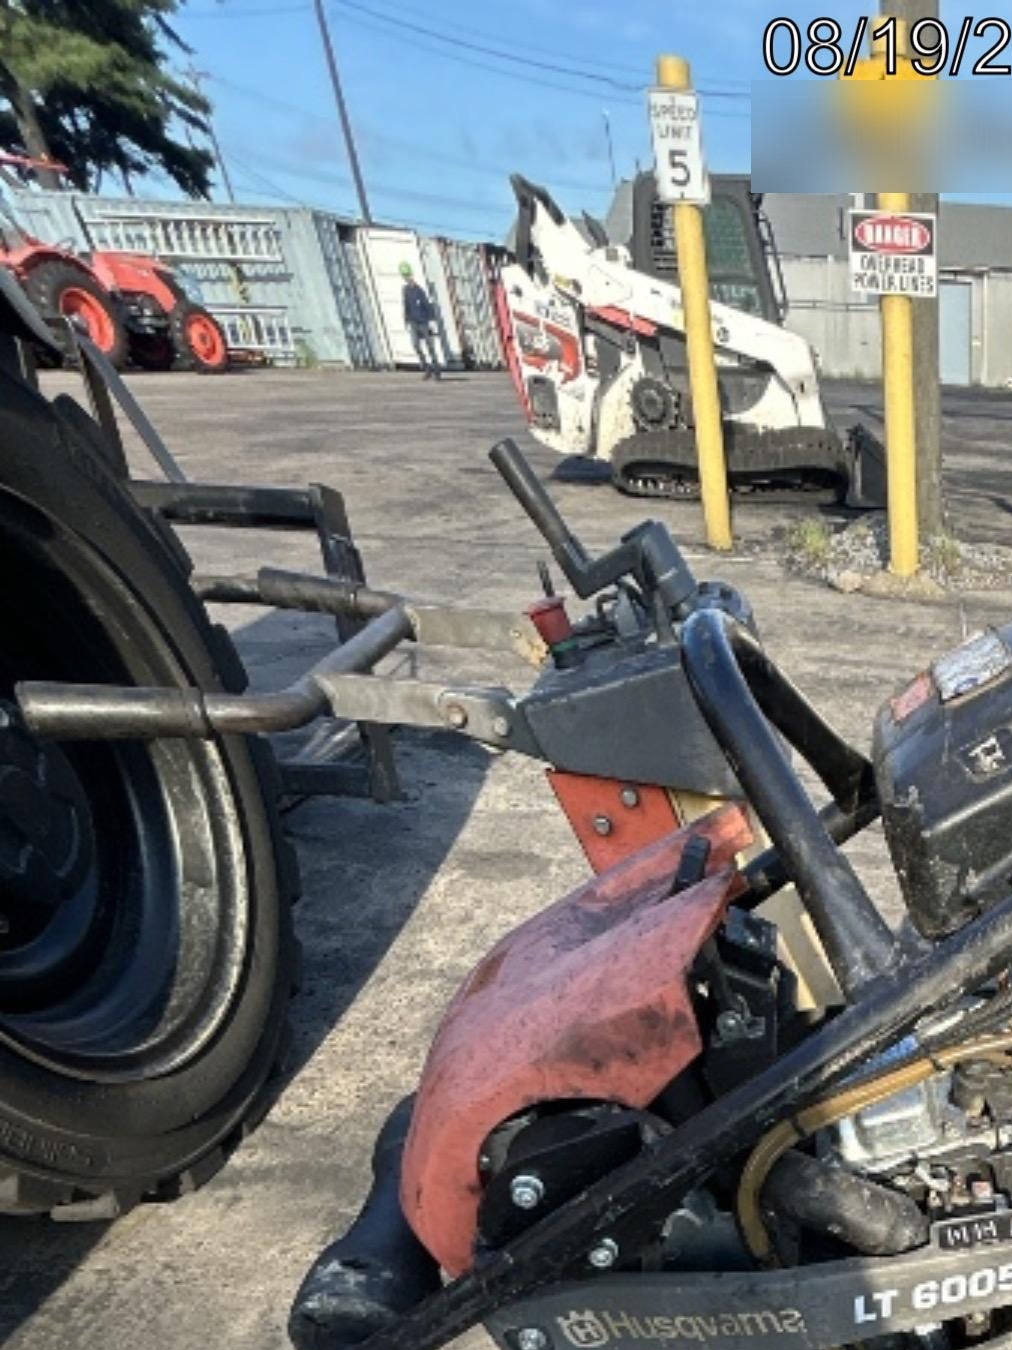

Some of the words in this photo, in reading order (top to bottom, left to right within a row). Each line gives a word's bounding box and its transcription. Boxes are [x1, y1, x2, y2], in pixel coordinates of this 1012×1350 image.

[651, 104, 697, 120] SPEED
[668, 149, 690, 187] 5
[863, 222, 921, 250] DANGER
[860, 254, 925, 274] OVERHEAD
[854, 271, 896, 291] POWER
[899, 275, 934, 292] LINES
[854, 1289, 898, 1324] LT
[600, 1308, 808, 1342] Husqvarna
